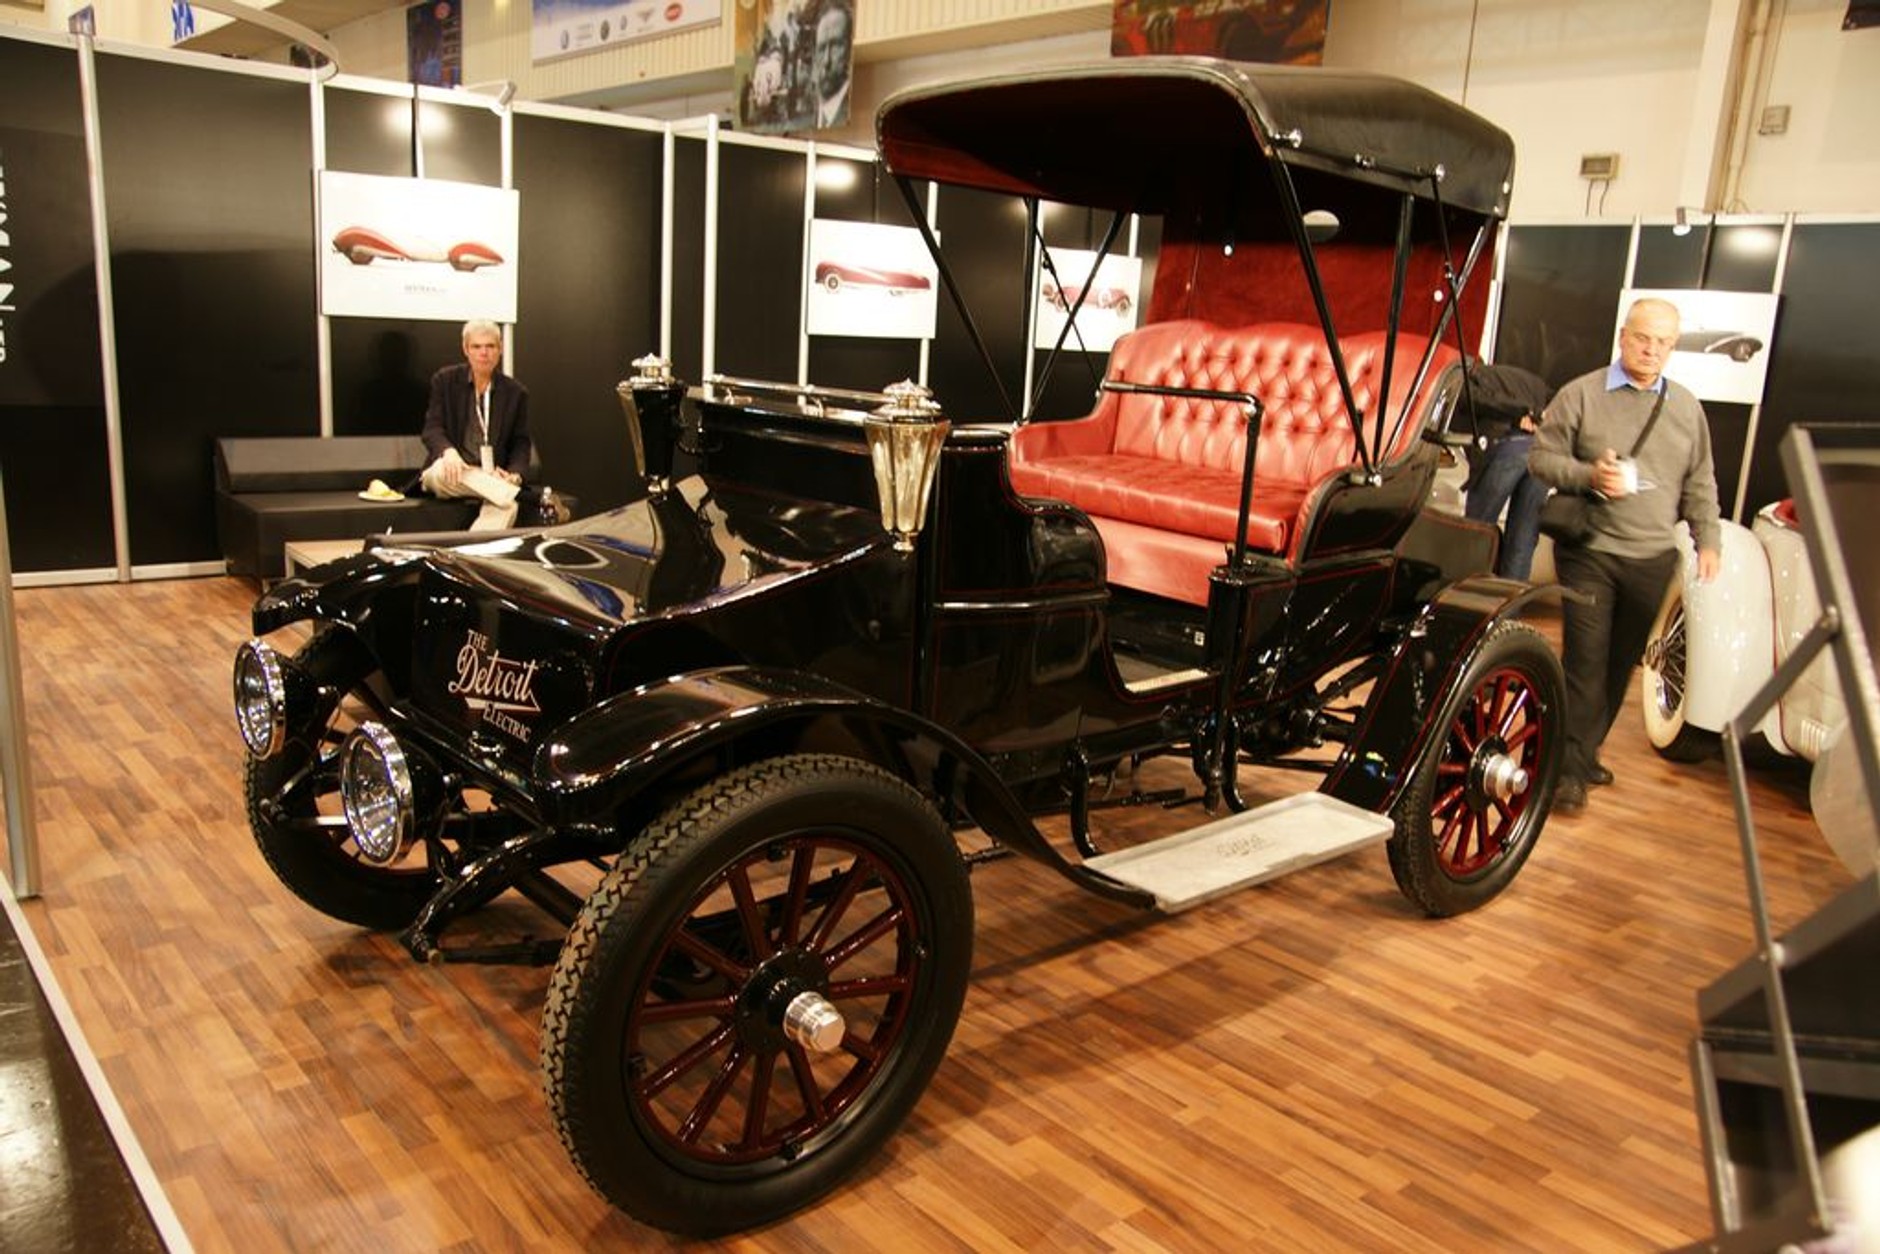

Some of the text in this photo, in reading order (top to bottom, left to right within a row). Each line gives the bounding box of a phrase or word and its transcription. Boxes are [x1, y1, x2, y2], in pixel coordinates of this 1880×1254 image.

[468, 629, 489, 652] THE
[448, 644, 541, 711] Detroit
[483, 703, 531, 743] ELECTRIC
